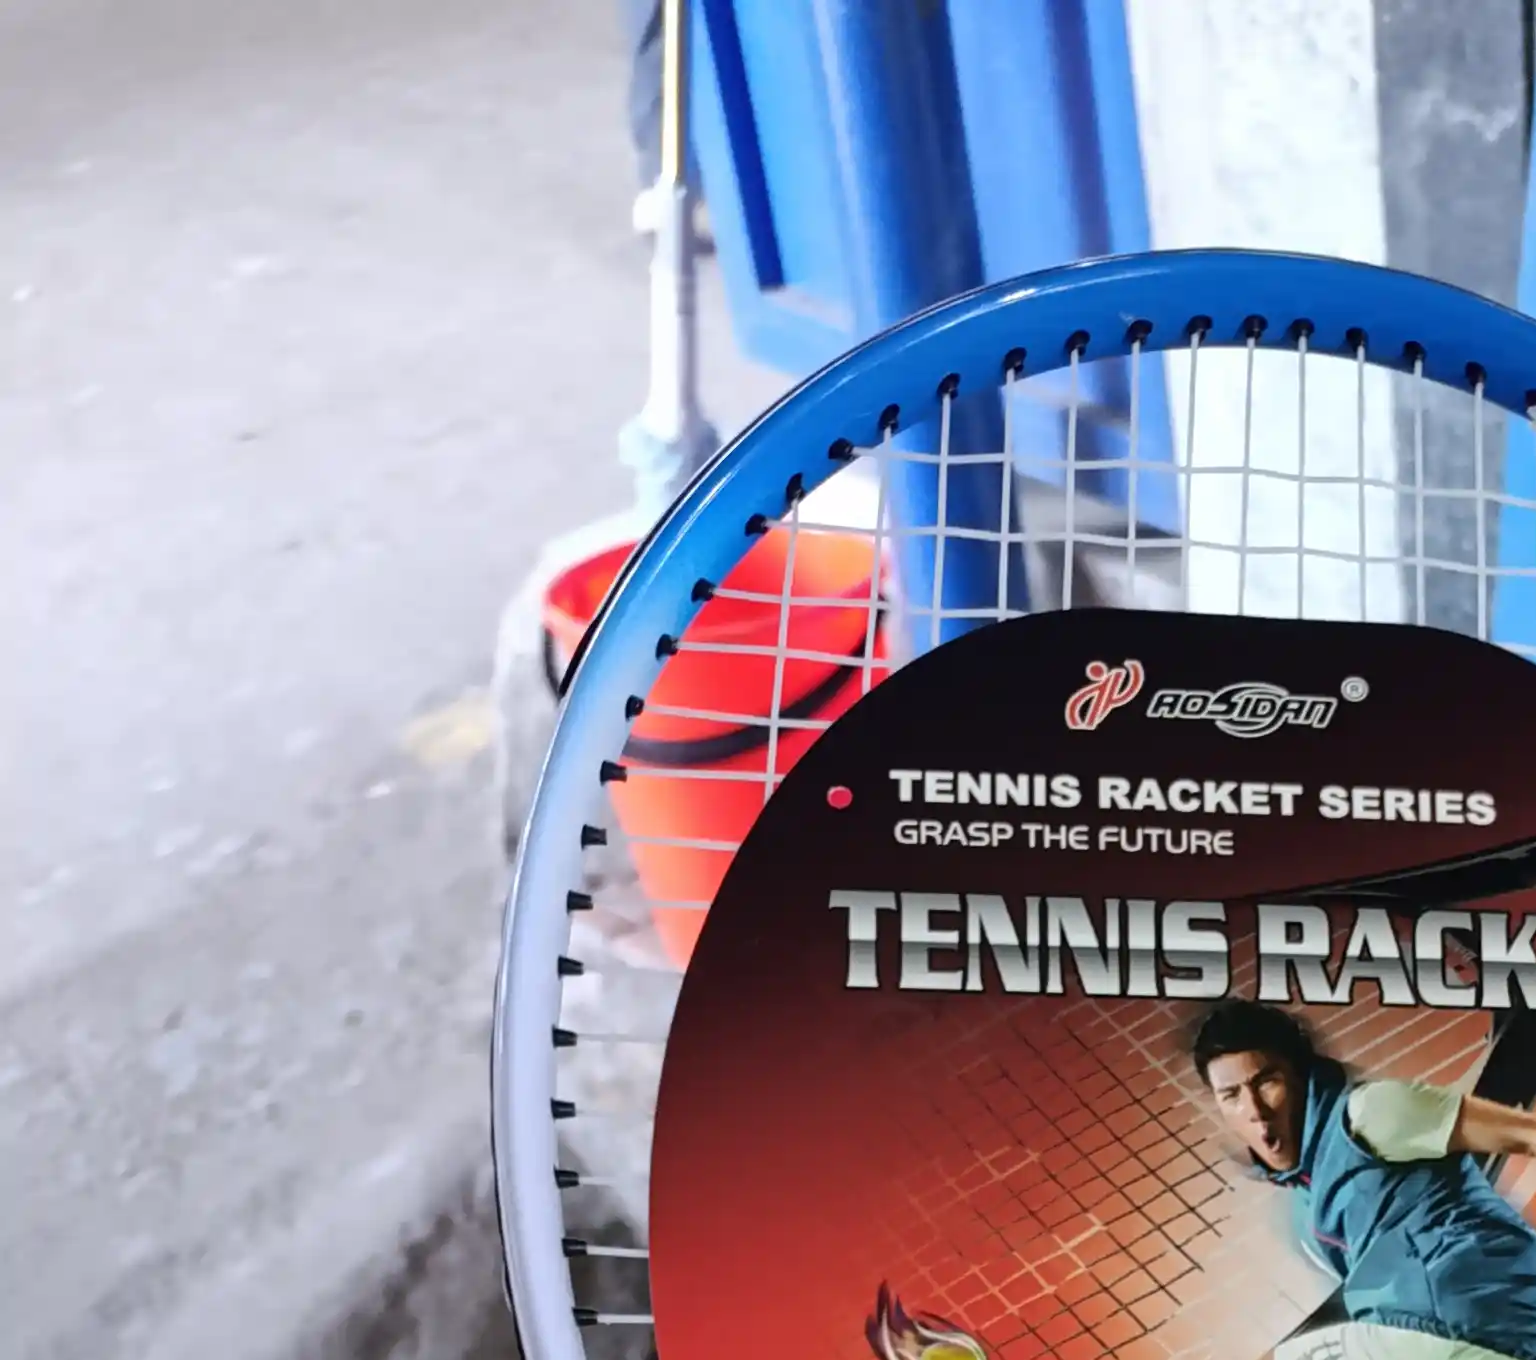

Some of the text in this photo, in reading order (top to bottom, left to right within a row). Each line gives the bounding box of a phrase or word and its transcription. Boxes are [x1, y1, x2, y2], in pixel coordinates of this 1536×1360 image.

[889, 769, 1496, 826] TENNIS RACKET SERIES
[893, 819, 1235, 857] GRASP THE FUTURE
[828, 889, 1230, 1001] TENNIS
